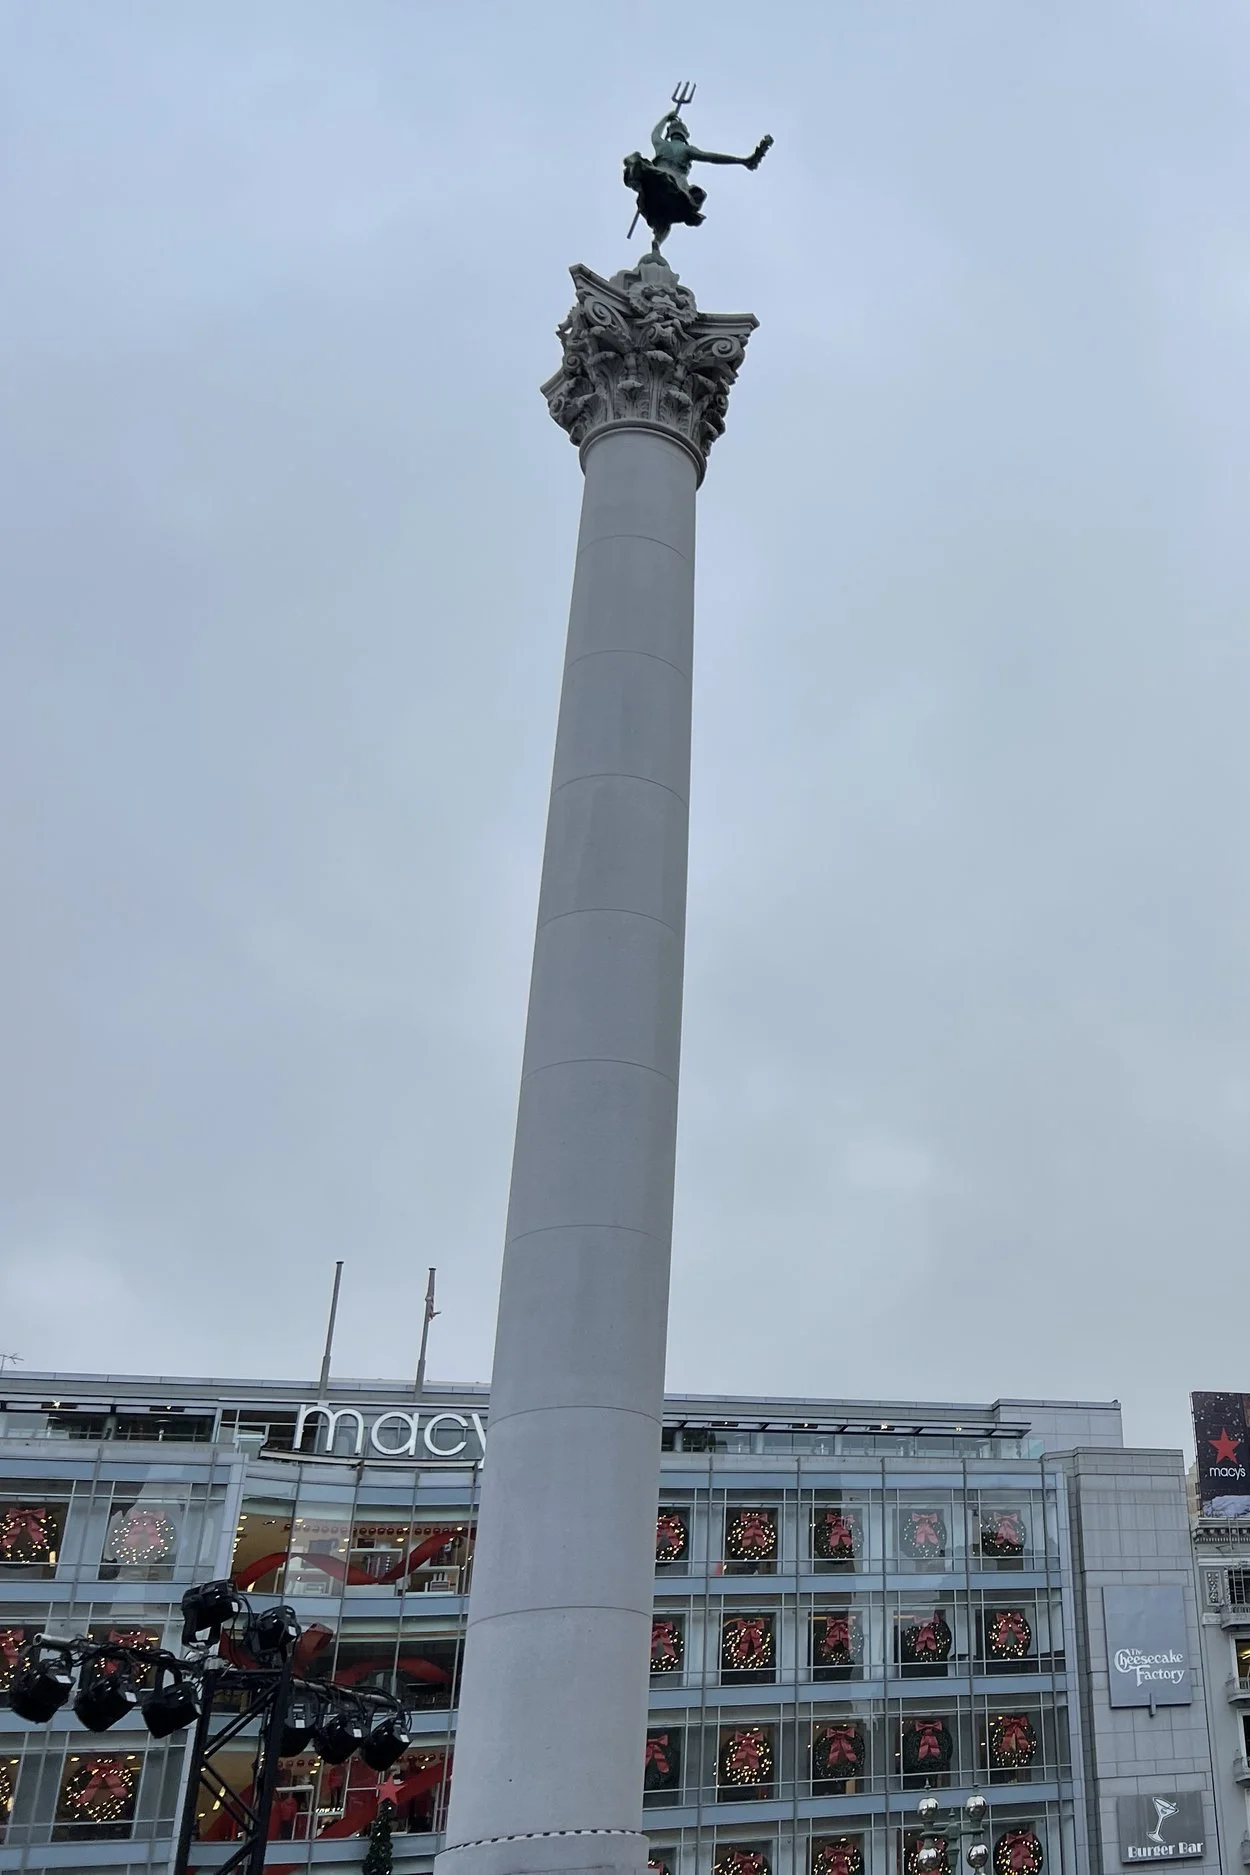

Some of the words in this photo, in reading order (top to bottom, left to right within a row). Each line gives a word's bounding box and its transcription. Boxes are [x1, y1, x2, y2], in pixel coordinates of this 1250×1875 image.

[1114, 1648, 1184, 1673] Cheesecake
[1128, 1664, 1185, 1687] Factory
[1127, 1844, 1176, 1859] Burger
[1178, 1841, 1204, 1855] Bar
